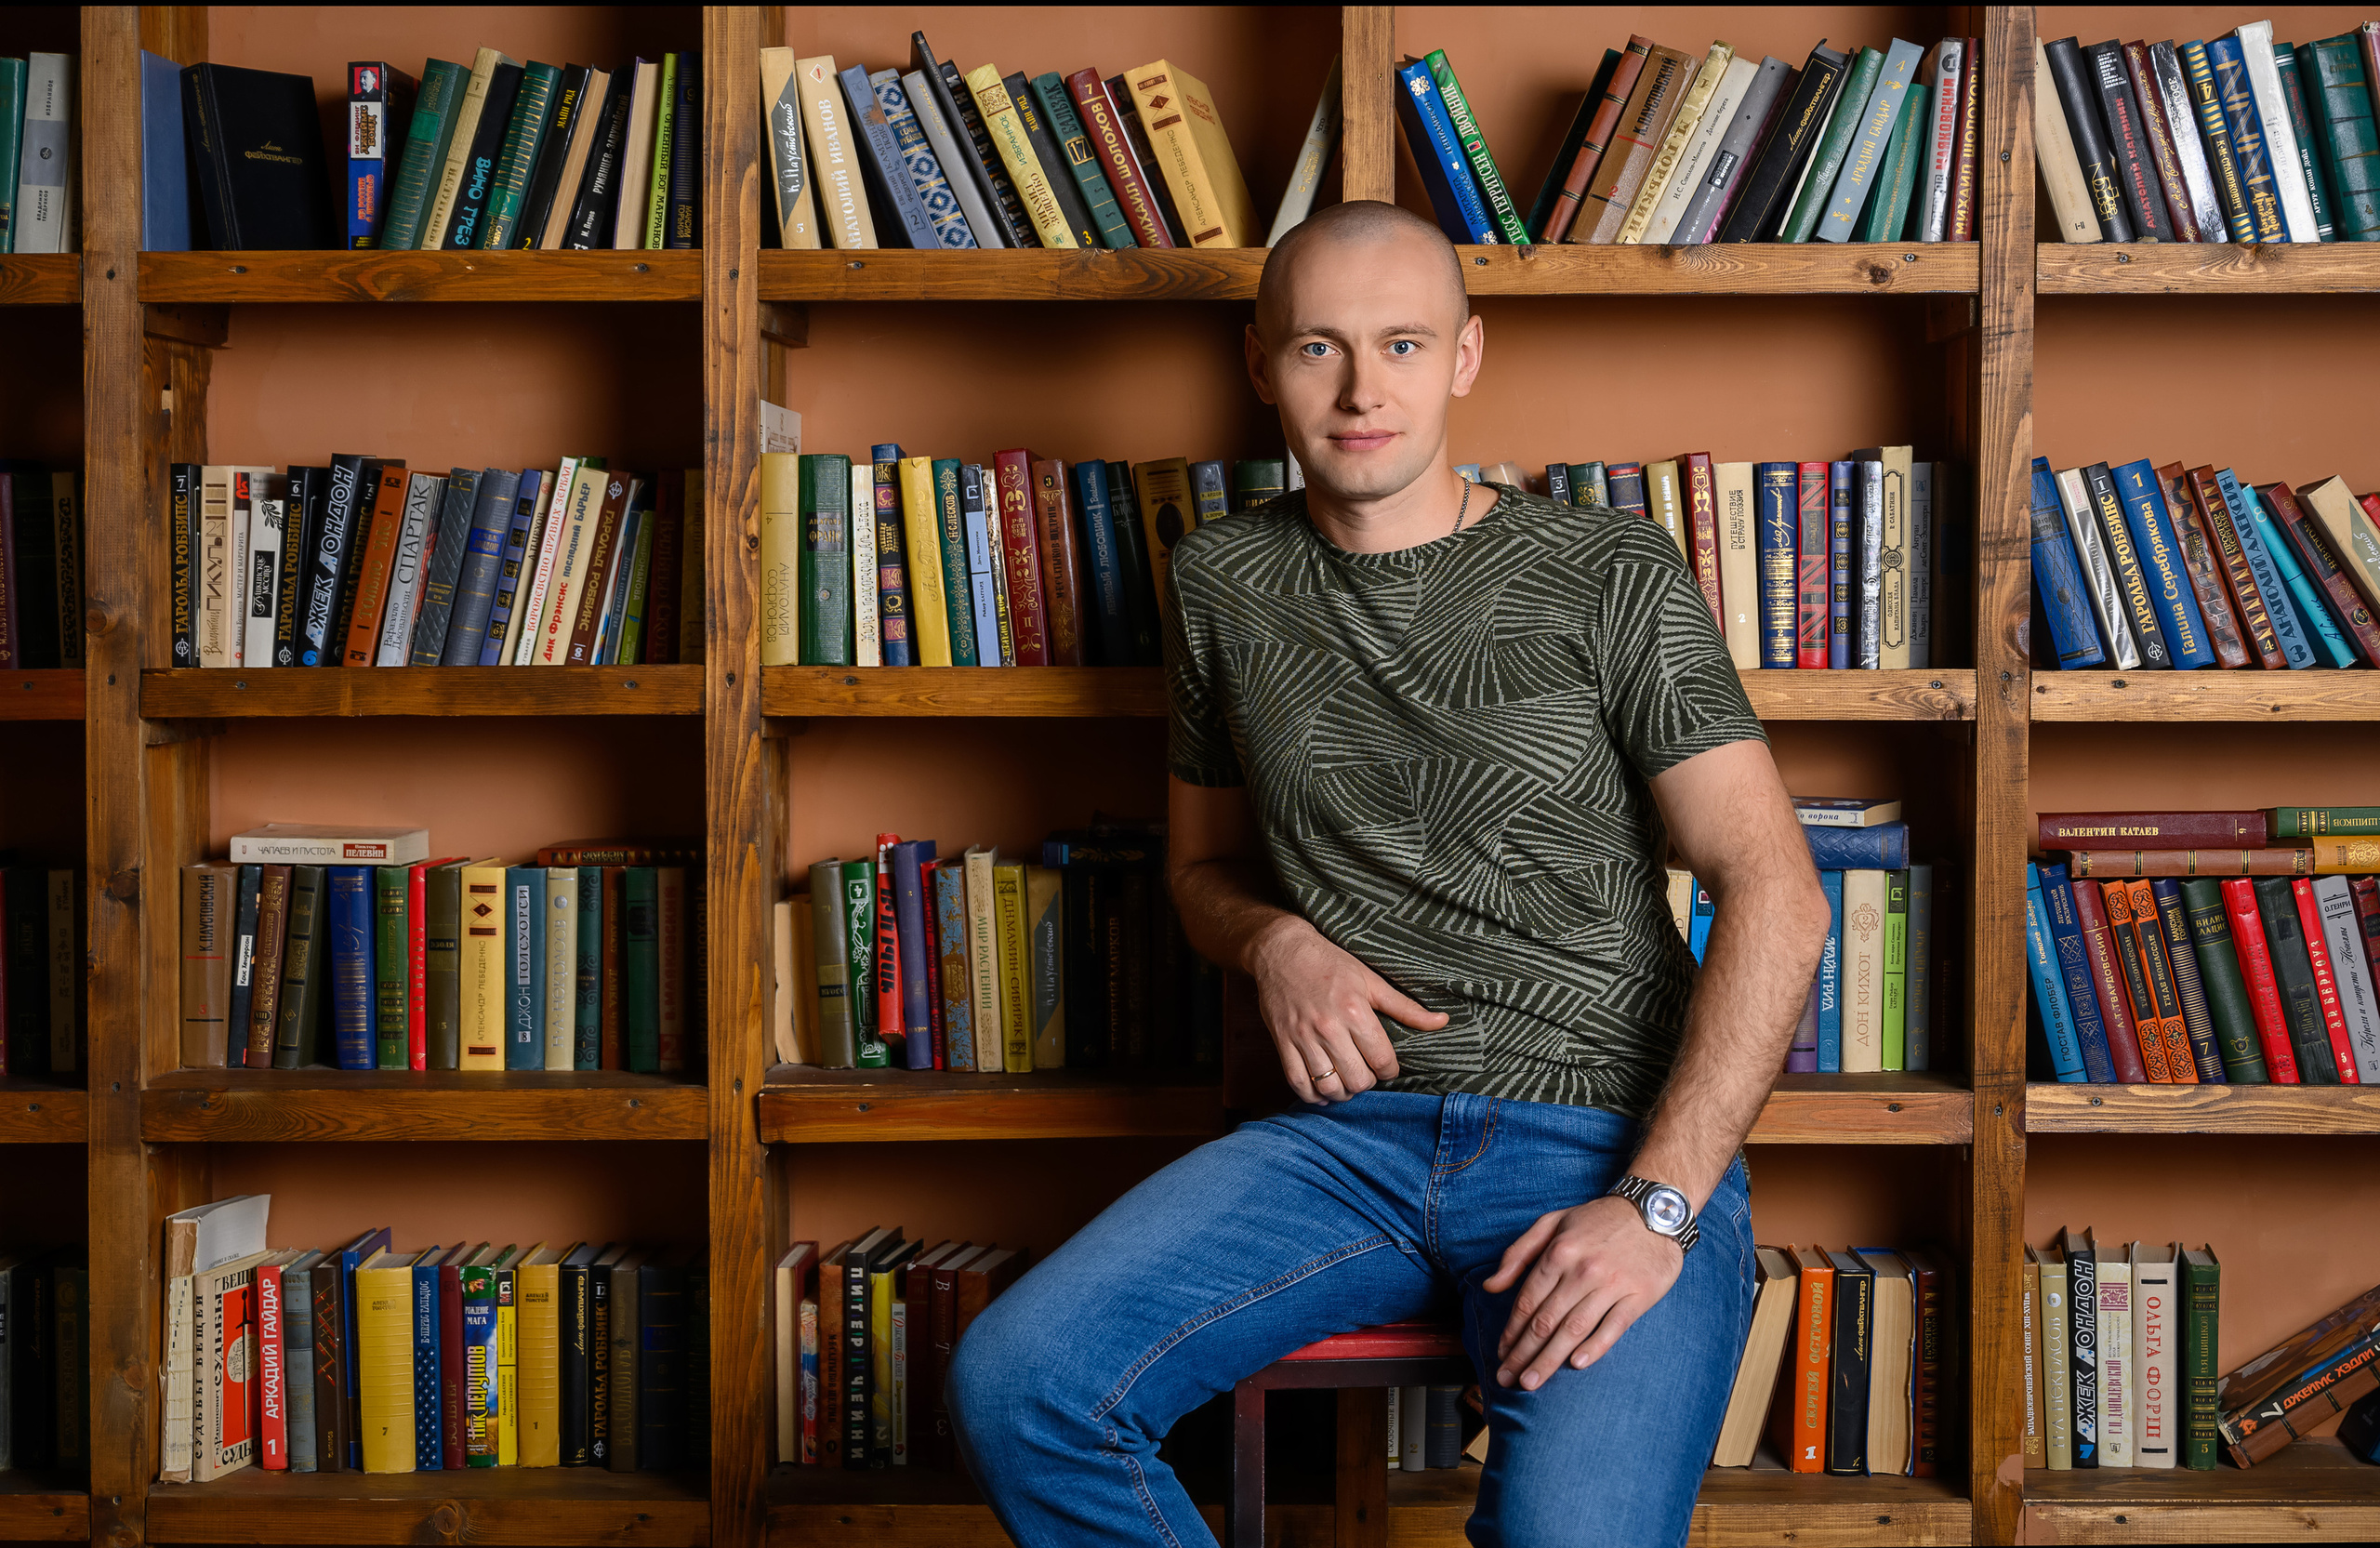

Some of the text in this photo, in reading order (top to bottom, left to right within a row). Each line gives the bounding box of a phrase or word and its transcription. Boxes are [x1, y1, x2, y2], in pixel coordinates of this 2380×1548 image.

[360, 105, 368, 154] ДЖЕЙМС
[367, 115, 377, 147] БОНД
[556, 88, 575, 128] МАЙН РИД
[817, 99, 844, 164] ИВАНОВ
[999, 114, 1027, 165] ИЗБРАННОЕ
[1016, 95, 1040, 132] МАЙН РИД
[1043, 83, 1078, 135] БАЛЬЗАК
[1424, 99, 1454, 154] ГЕПТАМЕРОН
[1935, 78, 1955, 170] МАЯКОВСКИЙ
[354, 145, 359, 154] ЯН
[1091, 102, 1161, 246] МИХАИЛ ШОЛОХОВ
[1440, 82, 1524, 244] ТЕСС ГЕРРИТСЕН ДВОЙНИК
[1851, 99, 1891, 185] АРКАДИЙ ГАЙДАР
[2115, 97, 2157, 229] АНАТОЛИЙ КАЛИНИН
[455, 157, 491, 245] ВИНО ГРЕЗ
[652, 113, 673, 249] ОГНЕННЫЙ БОГ МАРРАНОВ
[888, 175, 906, 205] ЕВГЕНИЙ
[1025, 183, 1051, 230] МИХАИЛ
[1030, 172, 1060, 225] ЗОЩЕНКО
[1166, 129, 1208, 226] АЛЕКСАНДР ЛЕБЕДЕНКО
[1453, 176, 1478, 225] МАРГАРИТА
[1460, 169, 1488, 225] НАВАРРСКАЯ
[1955, 164, 1972, 234] МИХАИЛ
[2301, 148, 2321, 214] АРТУР КОНАН ДОЙЛ
[358, 209, 365, 219] ИЗ
[676, 205, 685, 238] ГОРЬКИЙ
[684, 205, 693, 238] МАКСИМ
[1082, 231, 1092, 245] 3
[1088, 471, 1100, 504] Bestseller
[2132, 472, 2144, 487] 1
[397, 484, 430, 584] СПАРТАК
[527, 466, 572, 632] КОРОЛЕВСТВО КРИВЫХ ЗЕРКАЛ
[1729, 490, 1738, 549] ПУТЕШЕСТВИЕ
[1911, 524, 1920, 550] Антуан
[2214, 513, 2233, 555] ПРОСПЕР
[175, 495, 189, 634] ГАРОЛЬД РОББИНС
[205, 536, 223, 611] ПИКУЛЬ
[278, 503, 303, 641] ГАРОЛЬД РОББИНС
[306, 464, 354, 649] ДЖЕК ЛОНДОН
[542, 483, 591, 662] Дик Фрэнсис последний БАРЬЕР
[578, 509, 615, 631] ГАРОЛЬД РОББИНС
[1092, 511, 1117, 616] ЛЕНИВЫЙ ЛЮБОВНИК
[2100, 494, 2156, 634] ГАРОЛЬД РОББИНС
[2141, 501, 2197, 655] Галина Серебрякова
[2220, 475, 2297, 639] АНАТОЛИЙ АЛЕКСИН
[358, 559, 384, 619] ТОЛЬКО
[392, 590, 411, 650] Джованьоли
[766, 569, 777, 642] СОФРОНОВ
[778, 562, 790, 636] АНАТОЛИЙ
[1911, 576, 1919, 603] Памела
[383, 602, 400, 647] Рафаэлло
[1911, 611, 1919, 641] Джанни
[1919, 614, 1927, 638] Родари
[258, 846, 336, 855] ЧАПАЕВ И ПУСТОТА
[346, 849, 385, 857] ПЕЛЕВИН
[2058, 826, 2159, 838] ВАЛЕНТИН КАТАЕВ
[241, 936, 250, 969] Хендерсон
[1109, 917, 1121, 977] МАРКОВ
[2027, 899, 2048, 965] Госпожа Бовари
[2167, 909, 2180, 942] МАКСИМ
[2174, 906, 2188, 941] ГОРЬКИЙ
[518, 889, 533, 1029] ДЖОН ГОЛСУОРСИ
[977, 916, 992, 1009] МИР РАСТЕНИЙ
[1822, 933, 1835, 1012] МАЙН РИД
[2148, 934, 2165, 981] МОПАССАН
[2310, 940, 2335, 1004] БЕРРОУЗ
[2339, 926, 2364, 1006] капуста Новеллы
[478, 940, 486, 1041] АЛЕКСАНДР ЛЕБЕДЕНКО
[1856, 951, 1871, 1047] ДОН КИХОТ
[2045, 977, 2071, 1062] ГЮСТАВ ФЛОБЕР
[2200, 1042, 2209, 1055] 7
[419, 1280, 430, 1313] ГАЛЬДОС
[467, 1316, 487, 1326] МАГА
[213, 1292, 224, 1387] СУДЬБЫ
[262, 1278, 280, 1419] АРКАДИЙ ГАЙДАР
[593, 1302, 609, 1438] ГАРОЛЬД РОББИНС
[850, 1266, 865, 1459] ПИТЕР ЧЕЙНИ
[1805, 1281, 1825, 1429] СЕРГЕЙ ОСТРОВОЙ
[2074, 1258, 2096, 1444] ДЖЕК ЛОНДОН
[2146, 1296, 2162, 1439] ОЛЬГА ФОРШ
[194, 1294, 205, 1460] СУДЬБЫ ВЕЩЕЙ
[466, 1345, 490, 1440] Ник ПЕРУМОВ
[2025, 1355, 2035, 1436] ЗАПАДНОЕВРОПЕЙСКИЙ
[2283, 1348, 2376, 1409] ДЖЕЙМС ХЭДЛИ
[2261, 1402, 2284, 1419] 7
[268, 1438, 276, 1456] 1
[1805, 1446, 1817, 1460] 1
